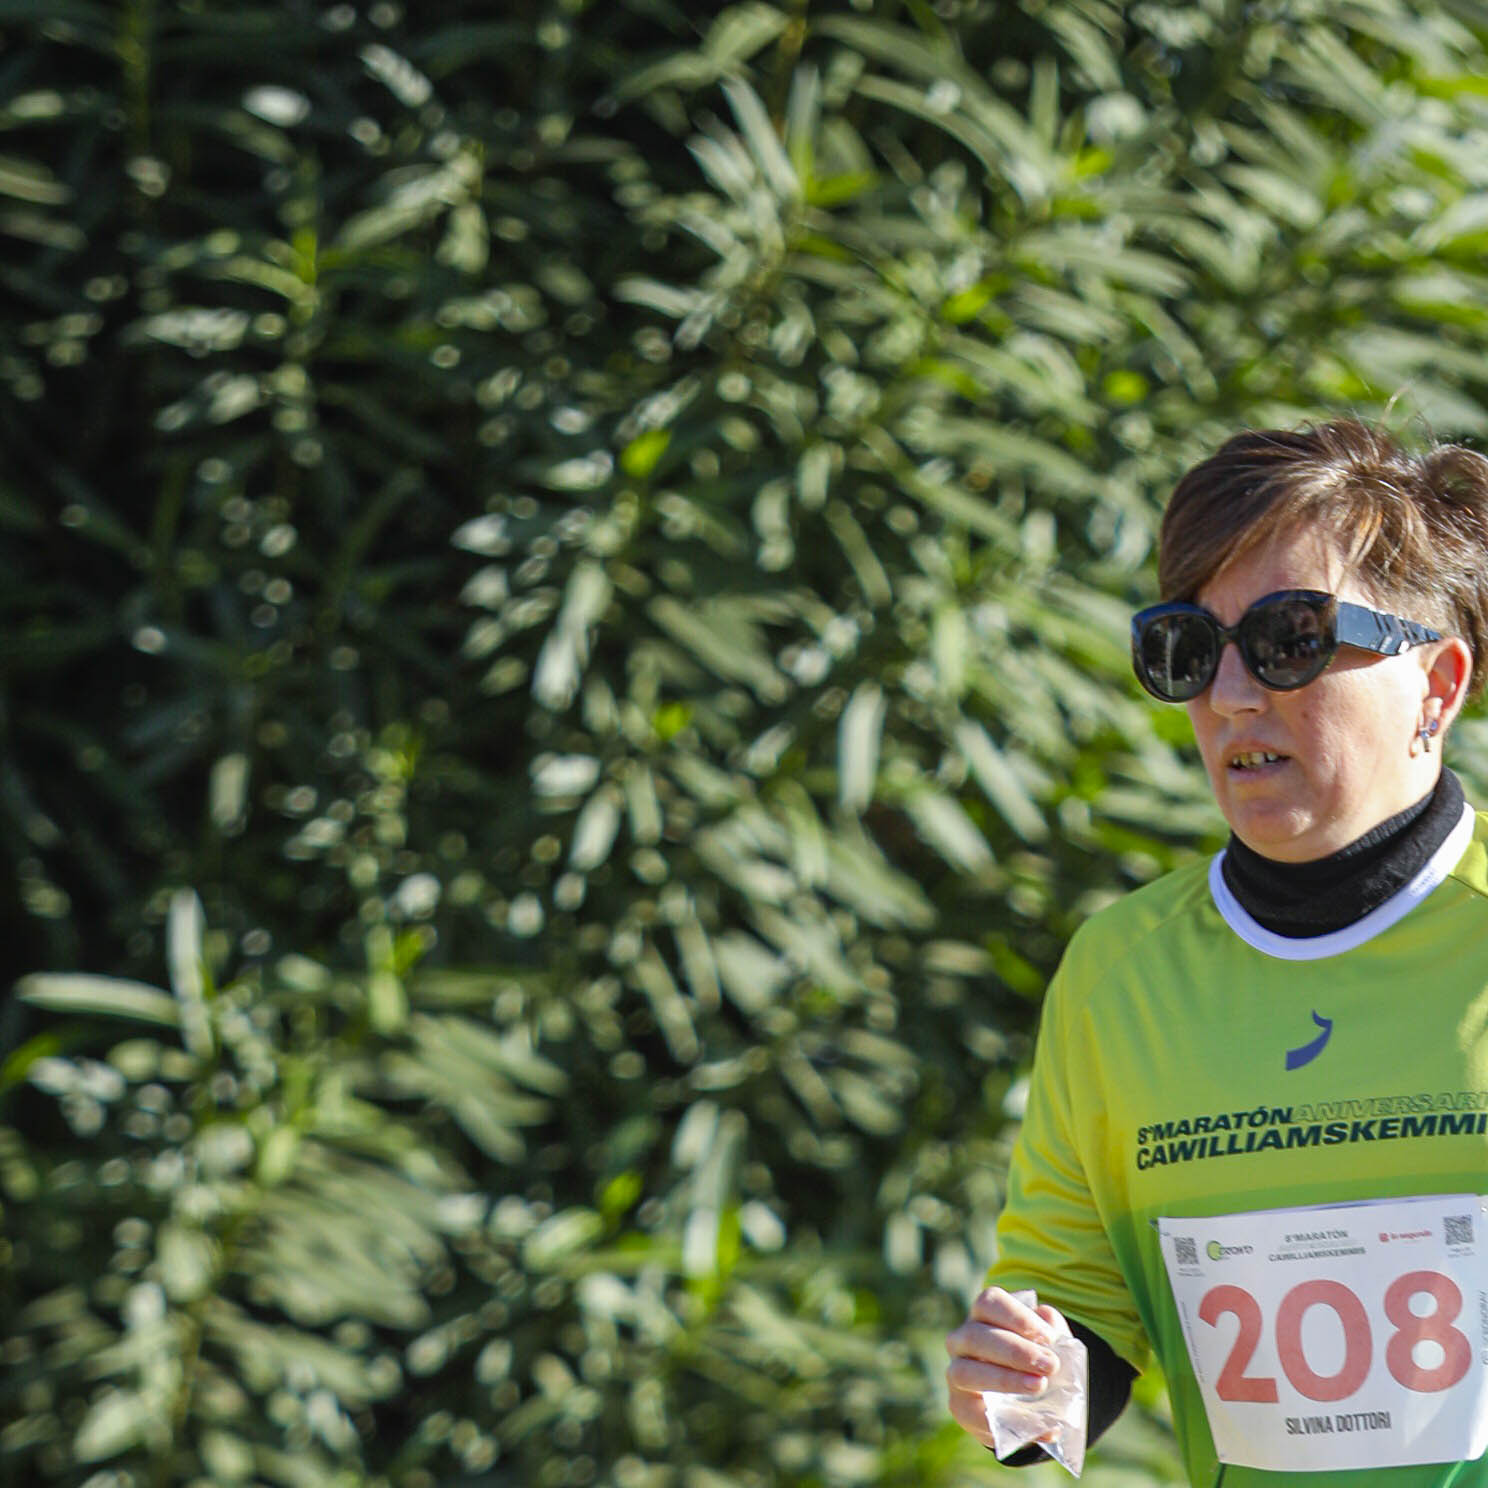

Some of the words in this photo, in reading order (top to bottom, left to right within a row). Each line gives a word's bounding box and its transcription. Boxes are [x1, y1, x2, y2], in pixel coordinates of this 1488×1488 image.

[1198, 1269, 1473, 1404] 208
[1285, 1415, 1335, 1436] SILVINA
[1335, 1410, 1393, 1433] DOTTORI
